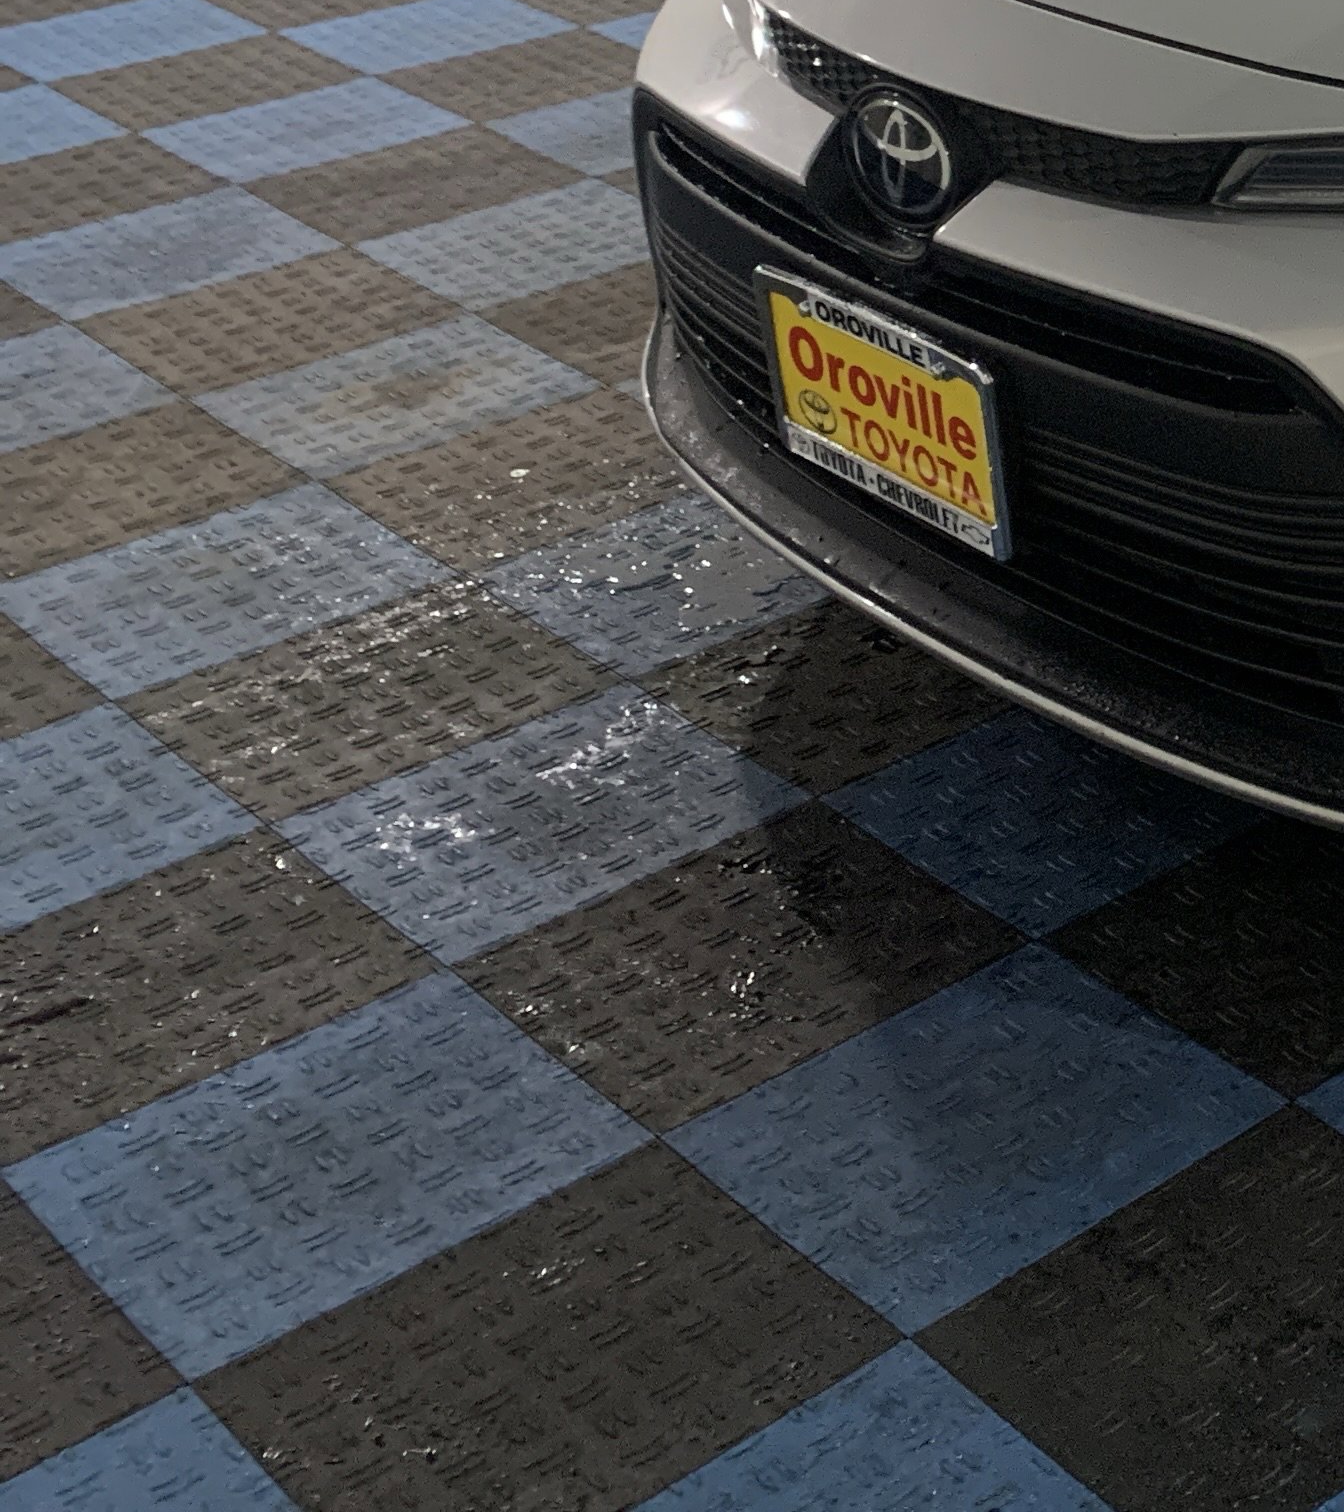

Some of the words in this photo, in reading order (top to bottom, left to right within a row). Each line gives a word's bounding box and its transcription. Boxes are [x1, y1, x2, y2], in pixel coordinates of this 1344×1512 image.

[815, 301, 926, 367] OROVILLE
[788, 325, 977, 461] Oroville
[812, 441, 867, 486] TOYOTA
[876, 473, 960, 535] CHEVROLET
[840, 405, 988, 516] TOYOTA
